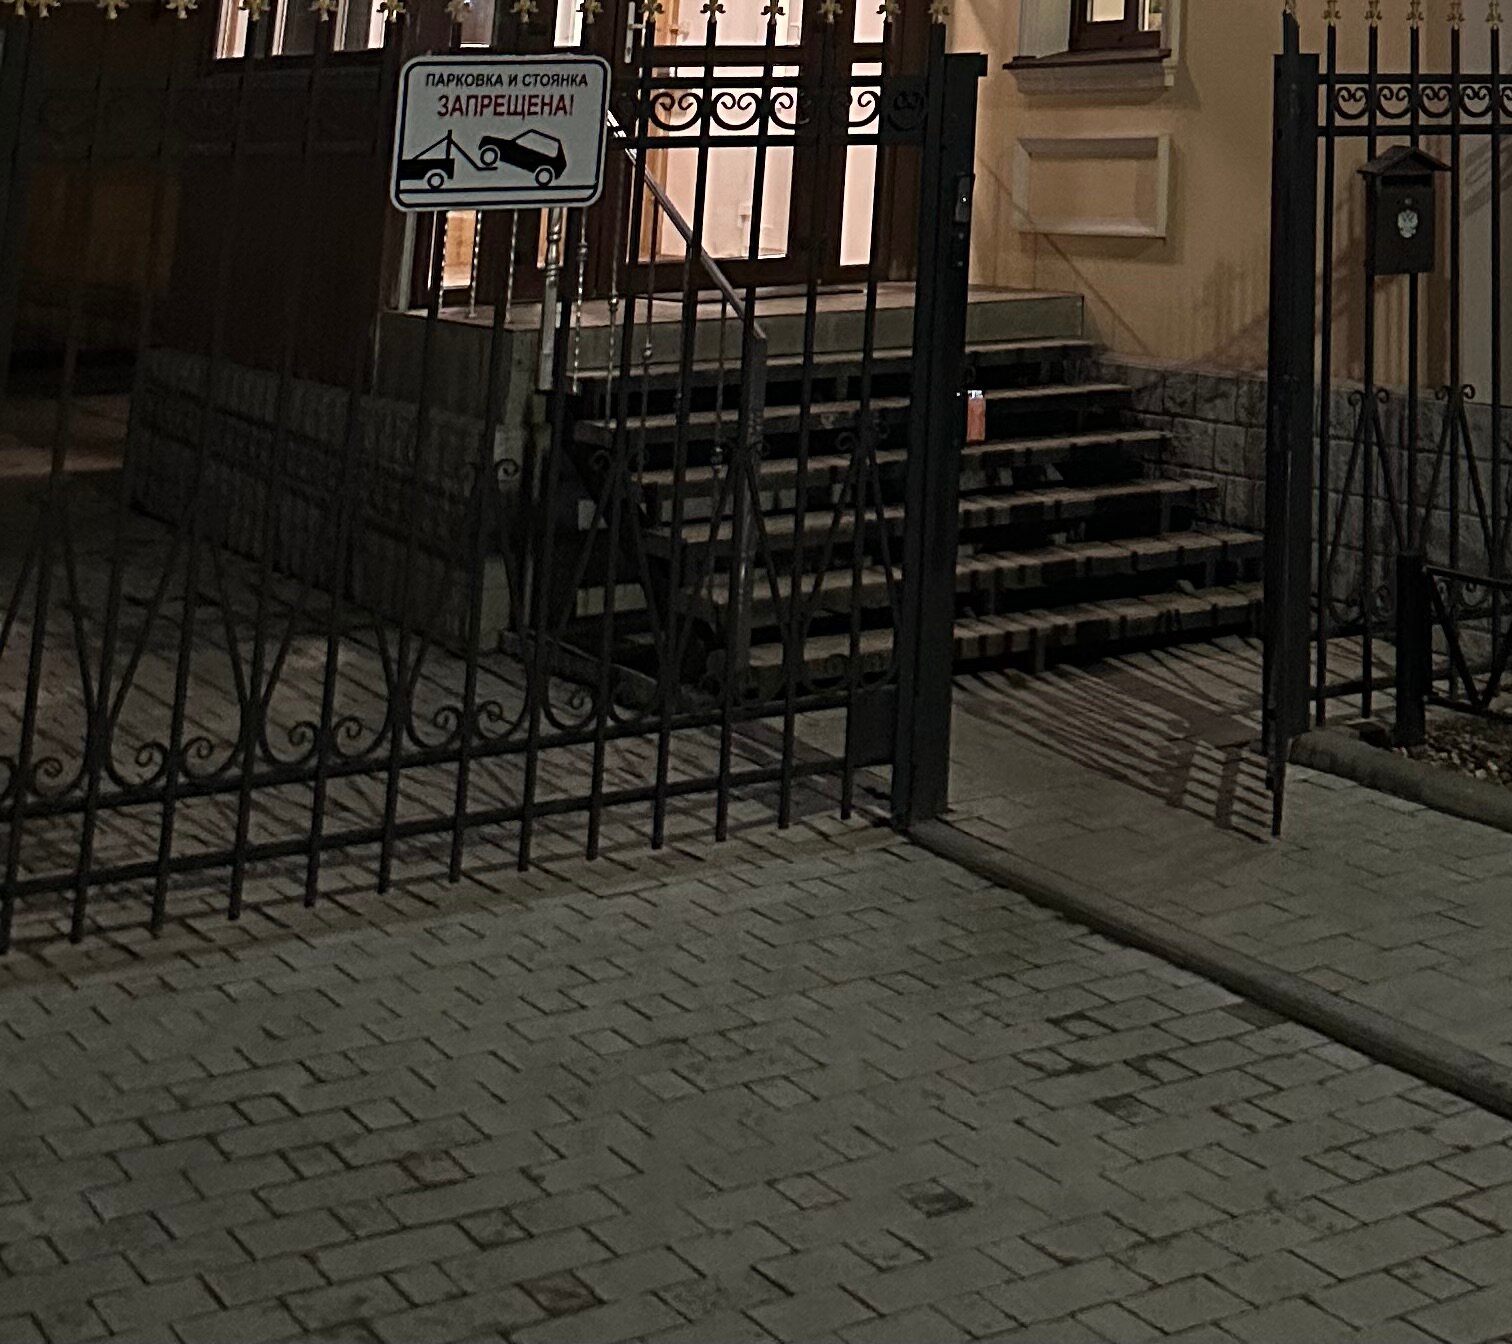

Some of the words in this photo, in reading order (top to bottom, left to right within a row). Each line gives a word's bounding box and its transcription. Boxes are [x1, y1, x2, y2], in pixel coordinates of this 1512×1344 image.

[425, 73, 504, 87] ПАРКОВКА
[508, 74, 518, 87] И
[522, 73, 588, 87] СТОЯНКА
[437, 94, 575, 120] ЗАПРЕЩЕНА!
